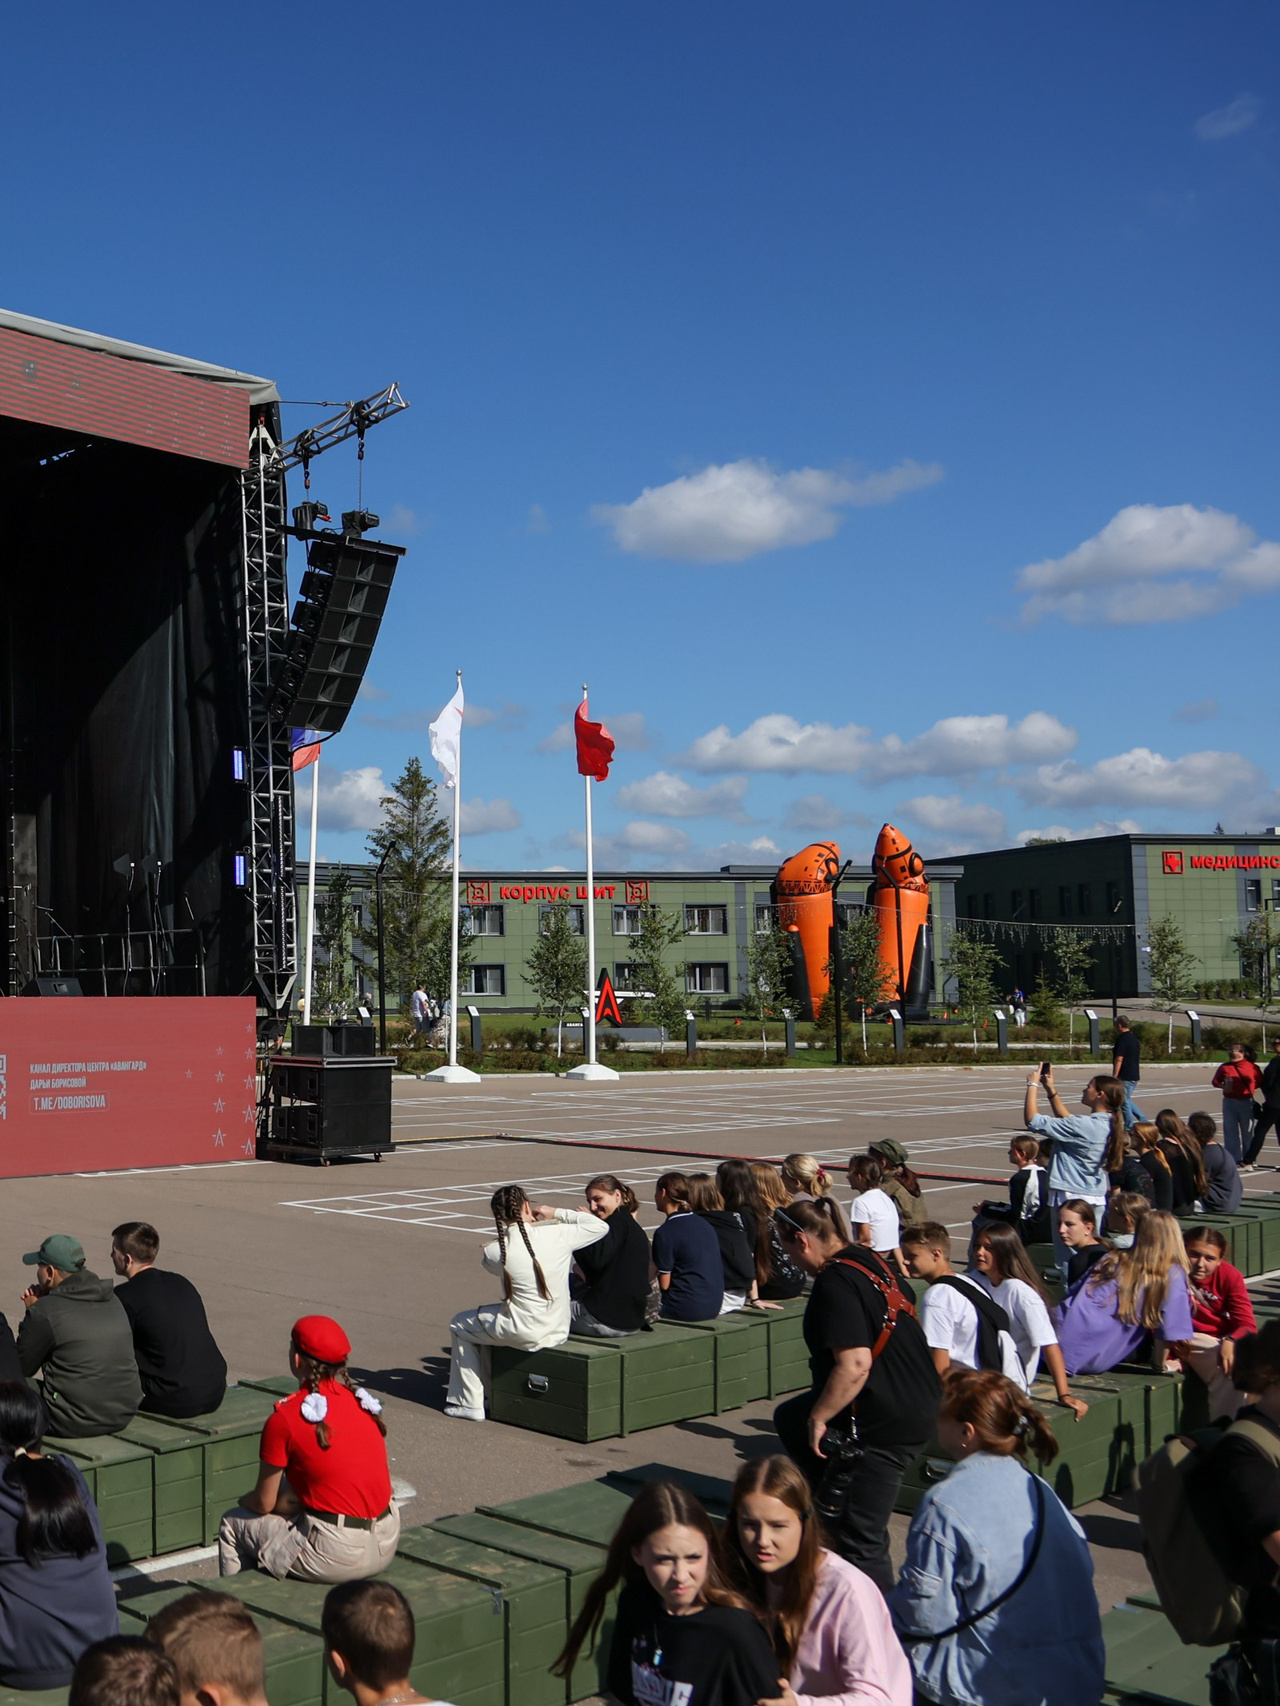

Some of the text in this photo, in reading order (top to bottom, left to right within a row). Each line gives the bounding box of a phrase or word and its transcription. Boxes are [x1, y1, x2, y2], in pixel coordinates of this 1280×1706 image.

[500, 886, 571, 904] корпус
[29, 1060, 147, 1074] КАНАЛ ДИРЕКТОРА ЦЕНТРА «АВАНГАРД»
[29, 1076, 87, 1090] ДАРЬИ БОРИСОВОЙ
[33, 1094, 106, 1111] T.ME/DOBORISOVA
